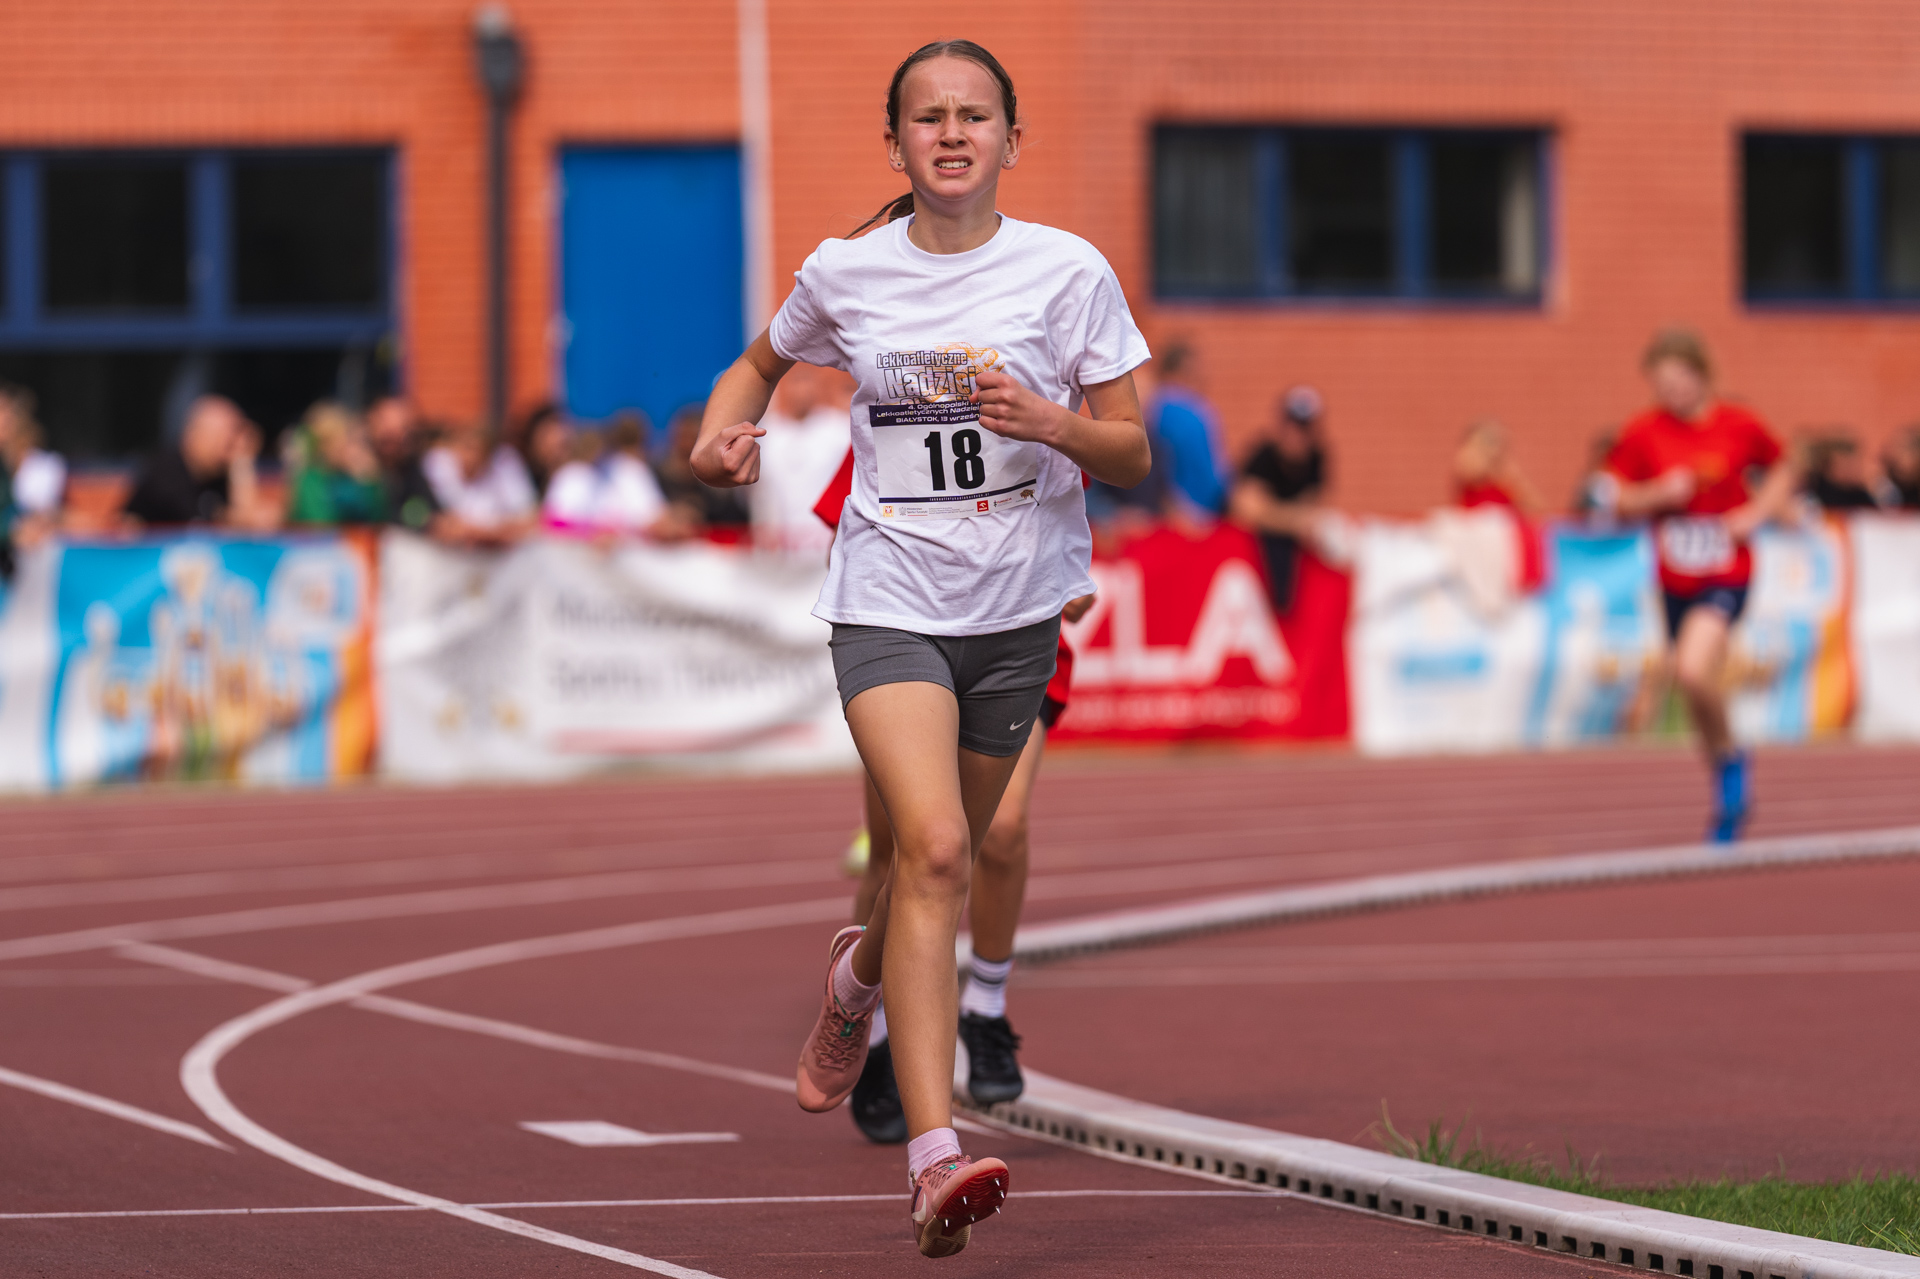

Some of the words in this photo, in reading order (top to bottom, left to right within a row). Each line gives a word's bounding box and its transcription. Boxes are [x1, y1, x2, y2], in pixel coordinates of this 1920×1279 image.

[877, 350, 968, 369] Lekkoatletyczne
[884, 365, 982, 399] Nadziej
[877, 408, 949, 418] Lekkoatletycznych
[917, 401, 969, 411] Ogólnopolski
[949, 413, 982, 422] wrześni
[924, 428, 986, 491] 18
